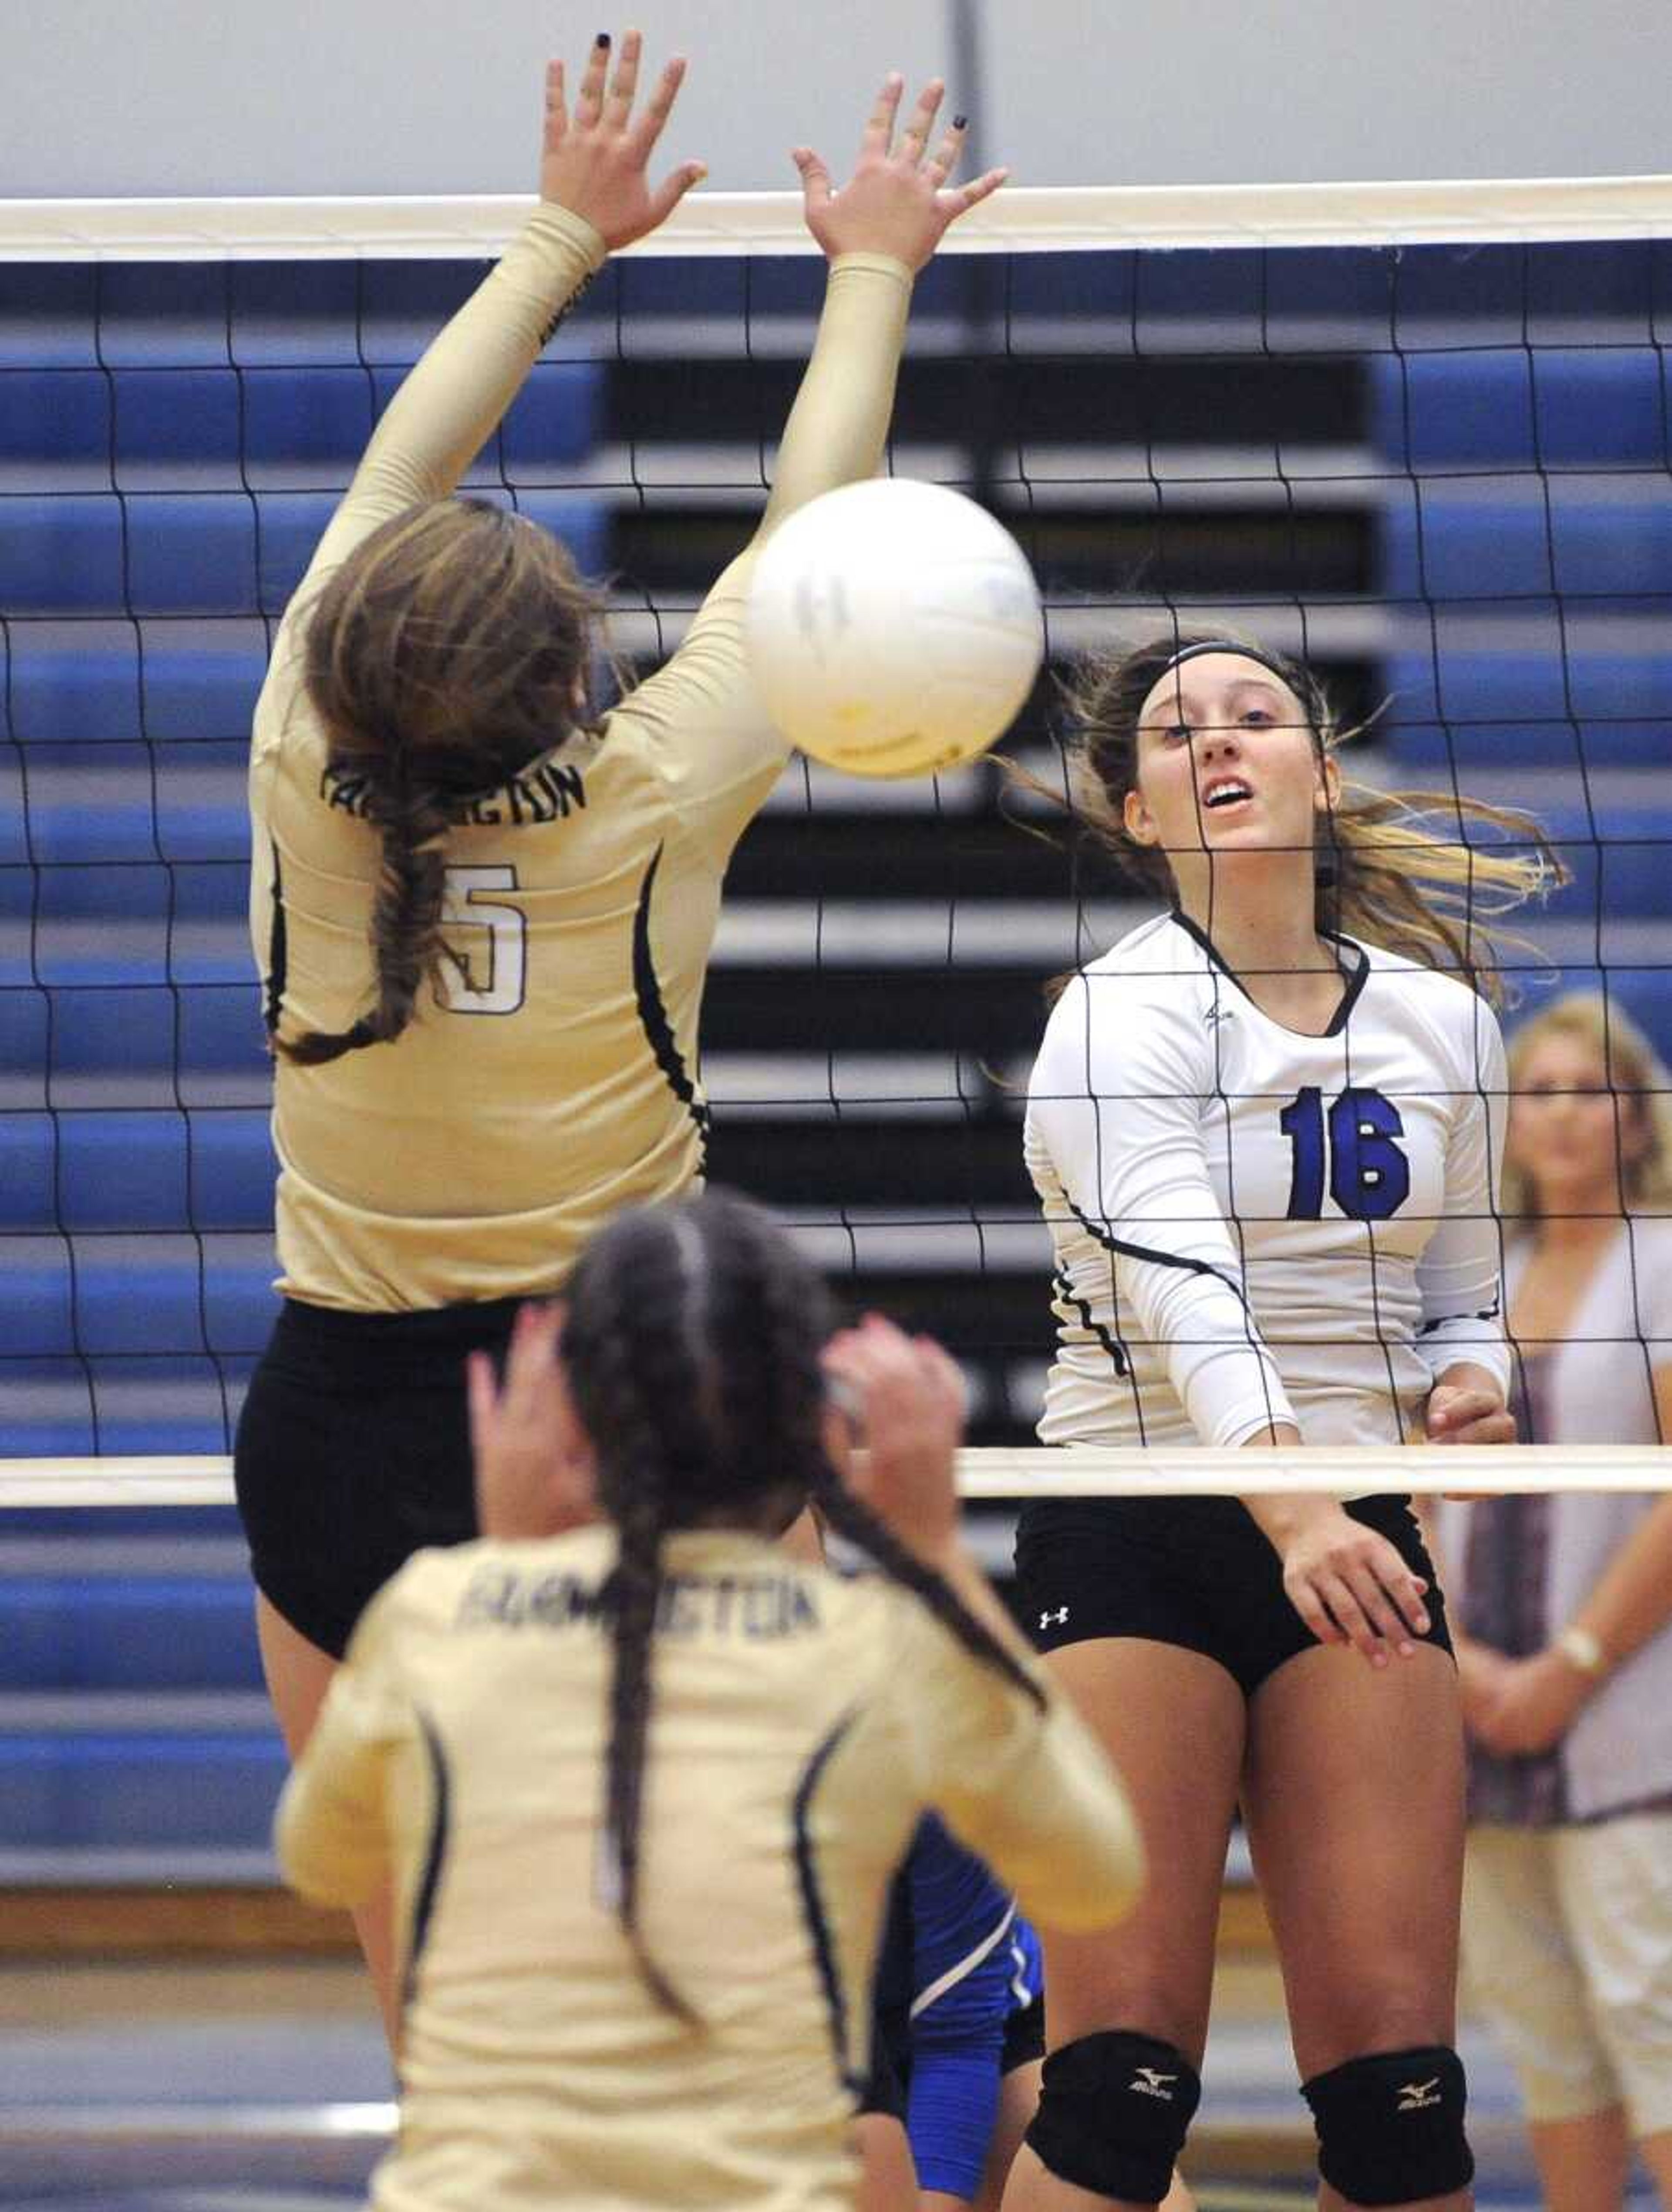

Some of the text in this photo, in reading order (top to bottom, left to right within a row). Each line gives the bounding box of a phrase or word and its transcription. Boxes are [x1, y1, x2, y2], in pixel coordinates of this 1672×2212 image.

[319, 763, 586, 826] FAGTON
[434, 865, 526, 1015] 5
[1280, 1086, 1410, 1220] 16
